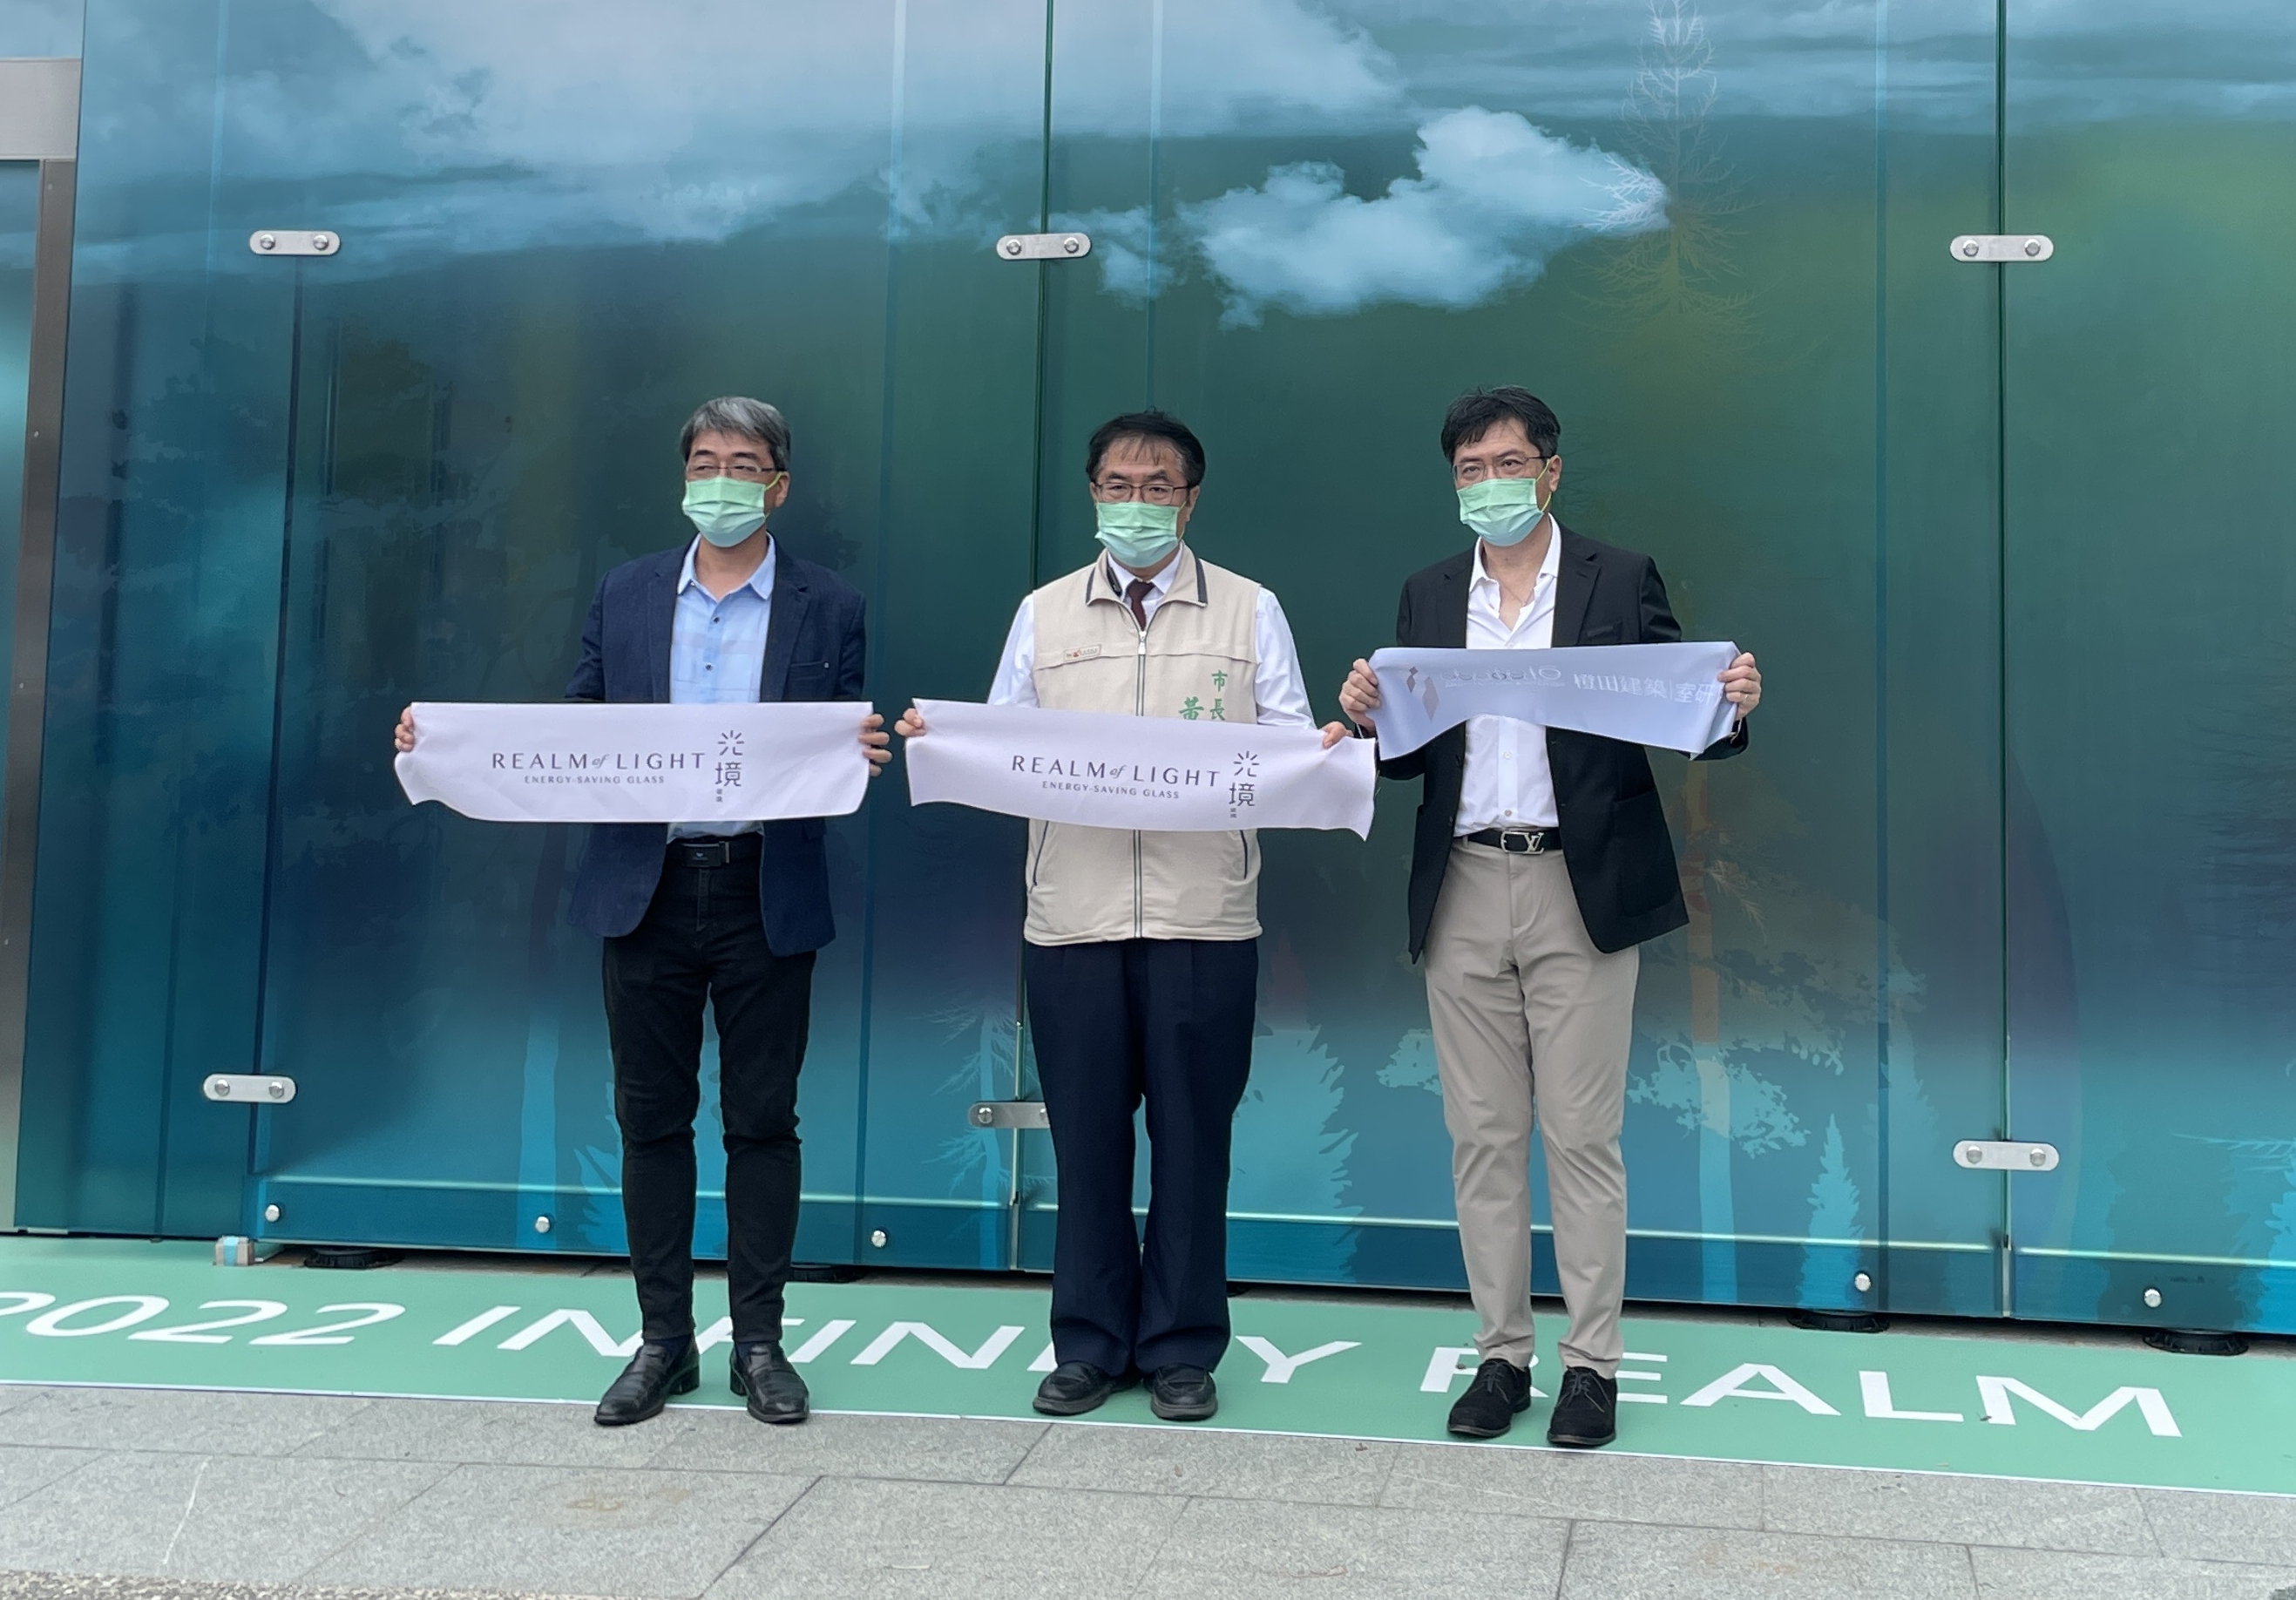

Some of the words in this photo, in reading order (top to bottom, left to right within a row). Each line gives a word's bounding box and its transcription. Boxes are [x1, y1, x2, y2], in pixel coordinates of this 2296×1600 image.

[1209, 668, 1229, 721] 市長
[491, 752, 588, 769] REALM
[592, 753, 610, 769] of
[616, 752, 706, 770] LIGHT
[524, 775, 621, 784] ENERGY-SAVING
[626, 775, 665, 784] GLASS
[715, 729, 745, 787] 光境
[1012, 754, 1106, 779] REALM
[1109, 764, 1128, 779] of
[1133, 764, 1221, 788] LIGHT
[1229, 749, 1260, 807] 光境
[1042, 780, 1138, 797] ENERGY-SAVING
[1142, 788, 1180, 799] GLASS
[1419, 1346, 2184, 1438] REALM
